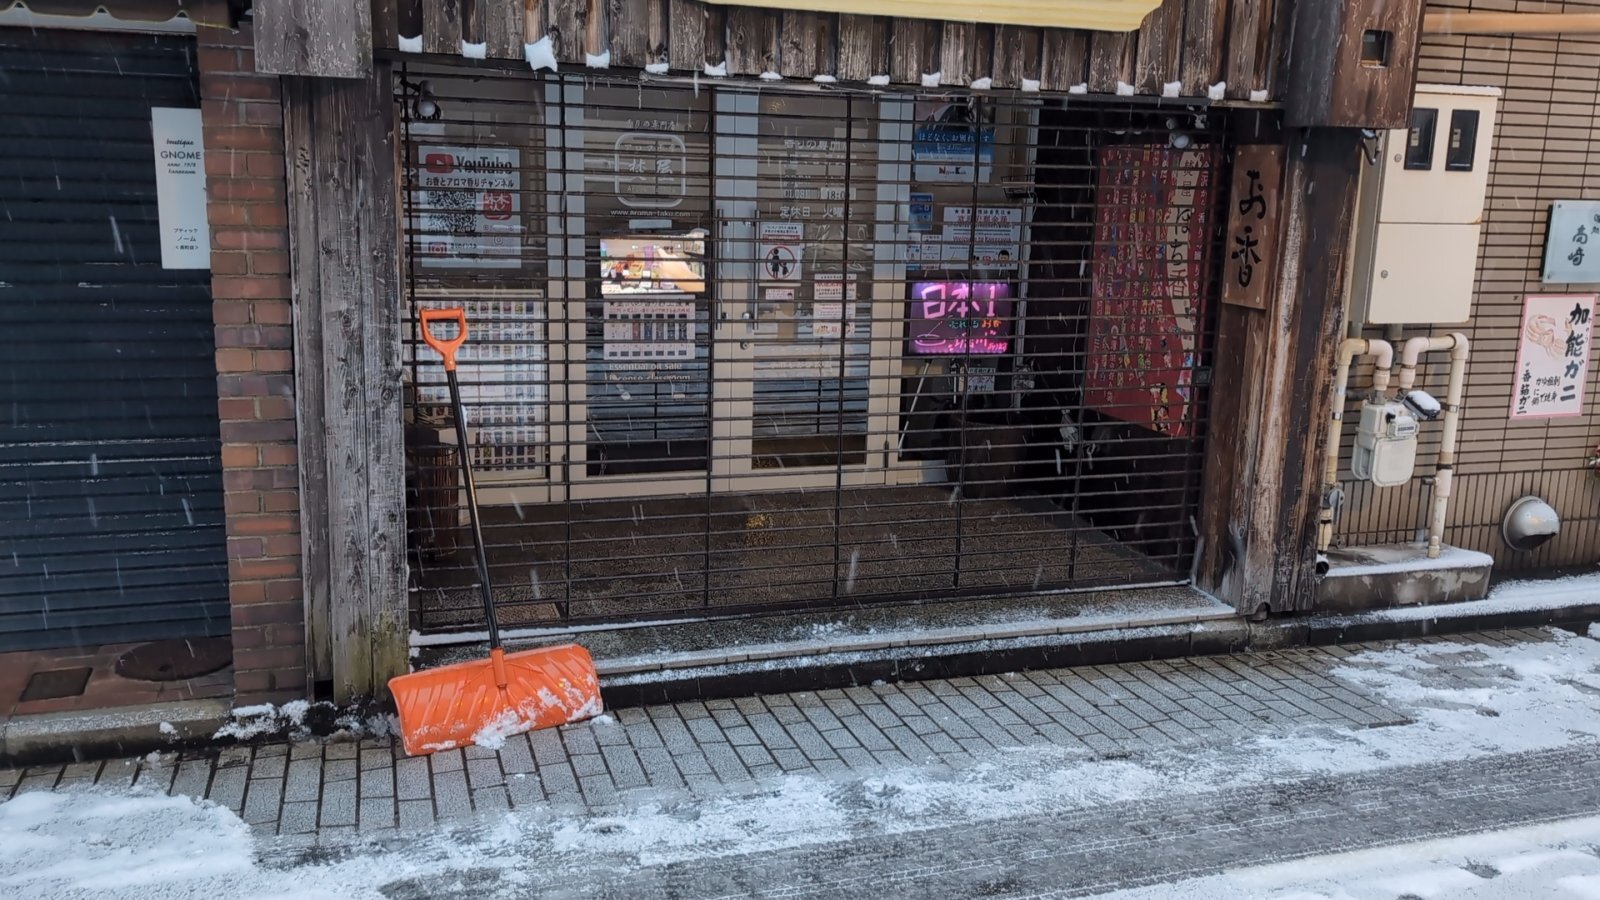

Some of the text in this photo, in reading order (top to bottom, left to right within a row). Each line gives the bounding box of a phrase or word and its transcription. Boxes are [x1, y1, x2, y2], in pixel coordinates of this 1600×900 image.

[919, 132, 989, 142] ほどなく、お別れす
[160, 150, 201, 160] GNOME
[456, 155, 513, 175] YouTube
[827, 190, 851, 200] 18:0
[780, 205, 811, 218] 定休日
[1231, 168, 1267, 288] お香
[1560, 302, 1590, 402] 加能ガニ
[609, 362, 648, 370] Essential
